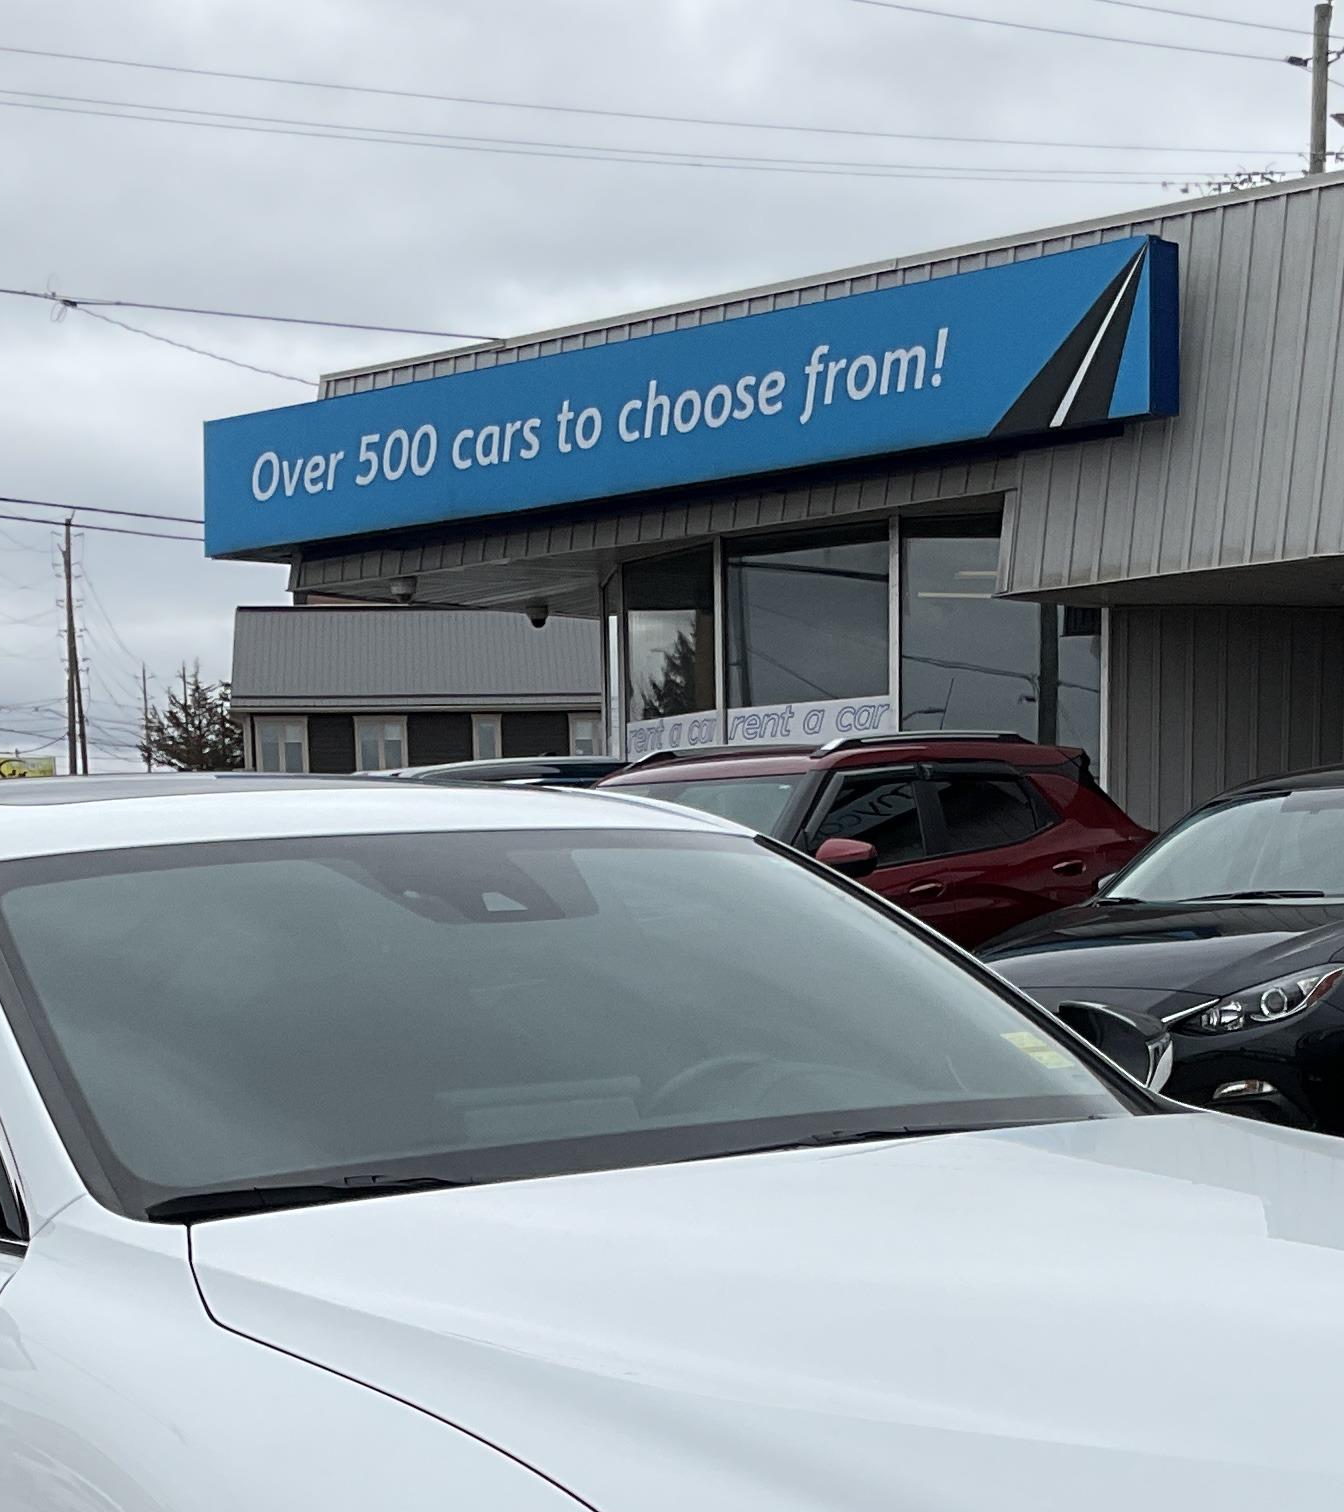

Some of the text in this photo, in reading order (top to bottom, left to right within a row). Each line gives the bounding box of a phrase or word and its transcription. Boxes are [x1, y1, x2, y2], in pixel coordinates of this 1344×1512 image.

[252, 327, 949, 501] Over 500 cars to choose from!
[629, 718, 717, 754] rent a car
[728, 703, 891, 741] rent a car
